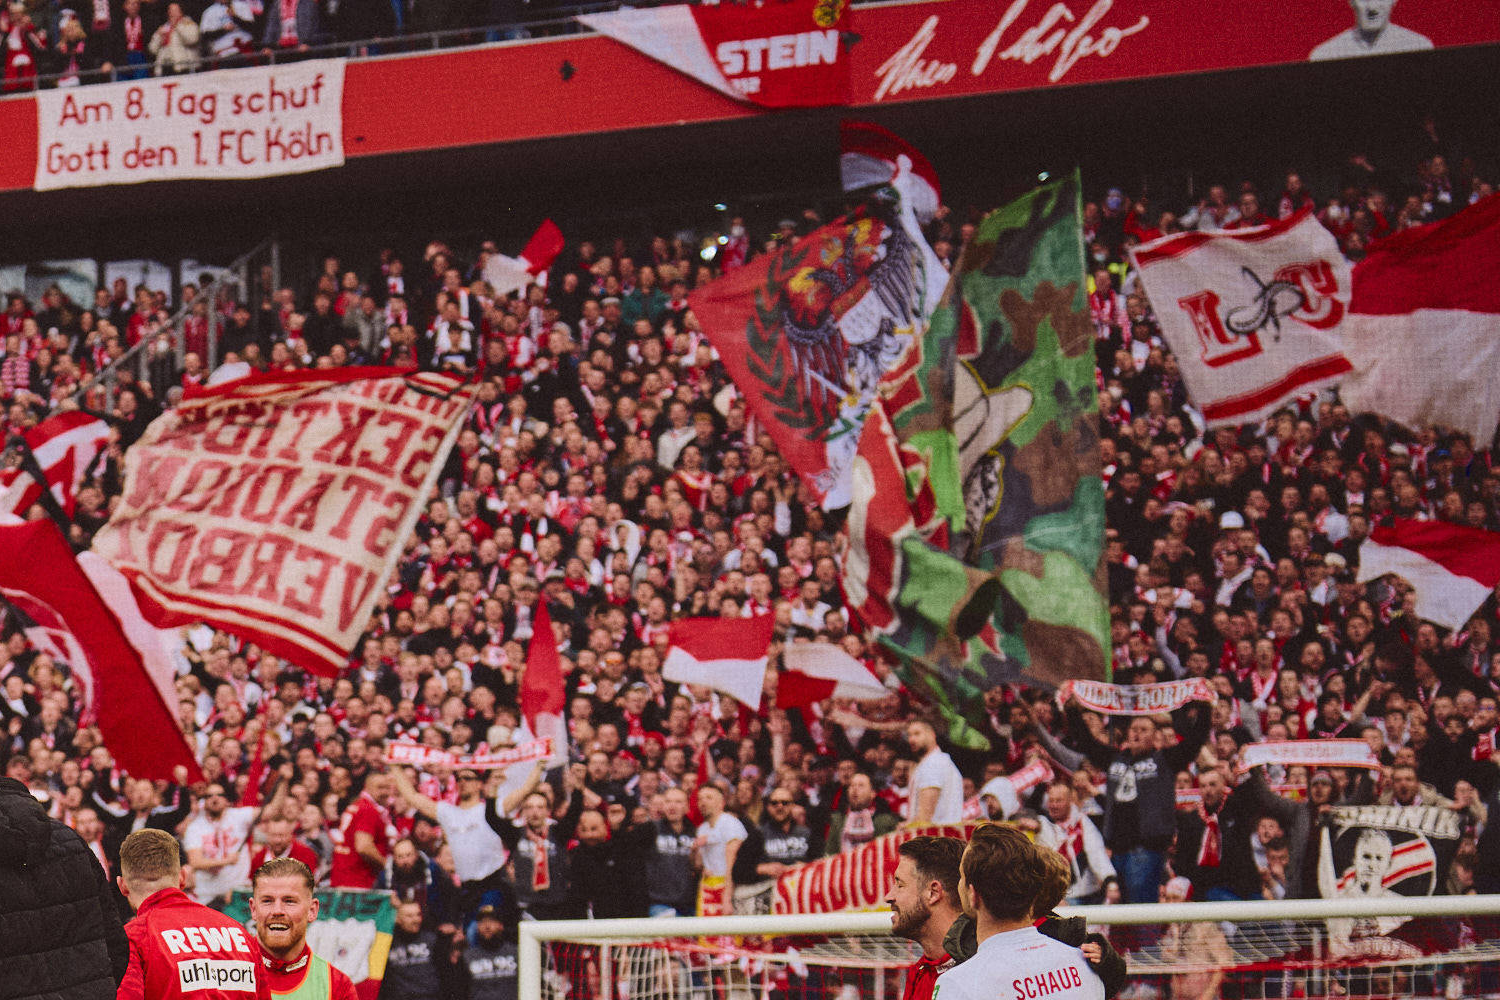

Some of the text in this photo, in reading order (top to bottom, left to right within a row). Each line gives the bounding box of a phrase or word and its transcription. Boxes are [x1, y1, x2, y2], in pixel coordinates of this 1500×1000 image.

[716, 29, 839, 75] STEIN
[59, 74, 324, 126] Am 8. Tag schuf
[46, 121, 333, 174] Gott den 1. FC Köln
[161, 926, 251, 955] REWE
[182, 962, 254, 986] uhlsport
[1013, 966, 1082, 1000] SCHAUB
